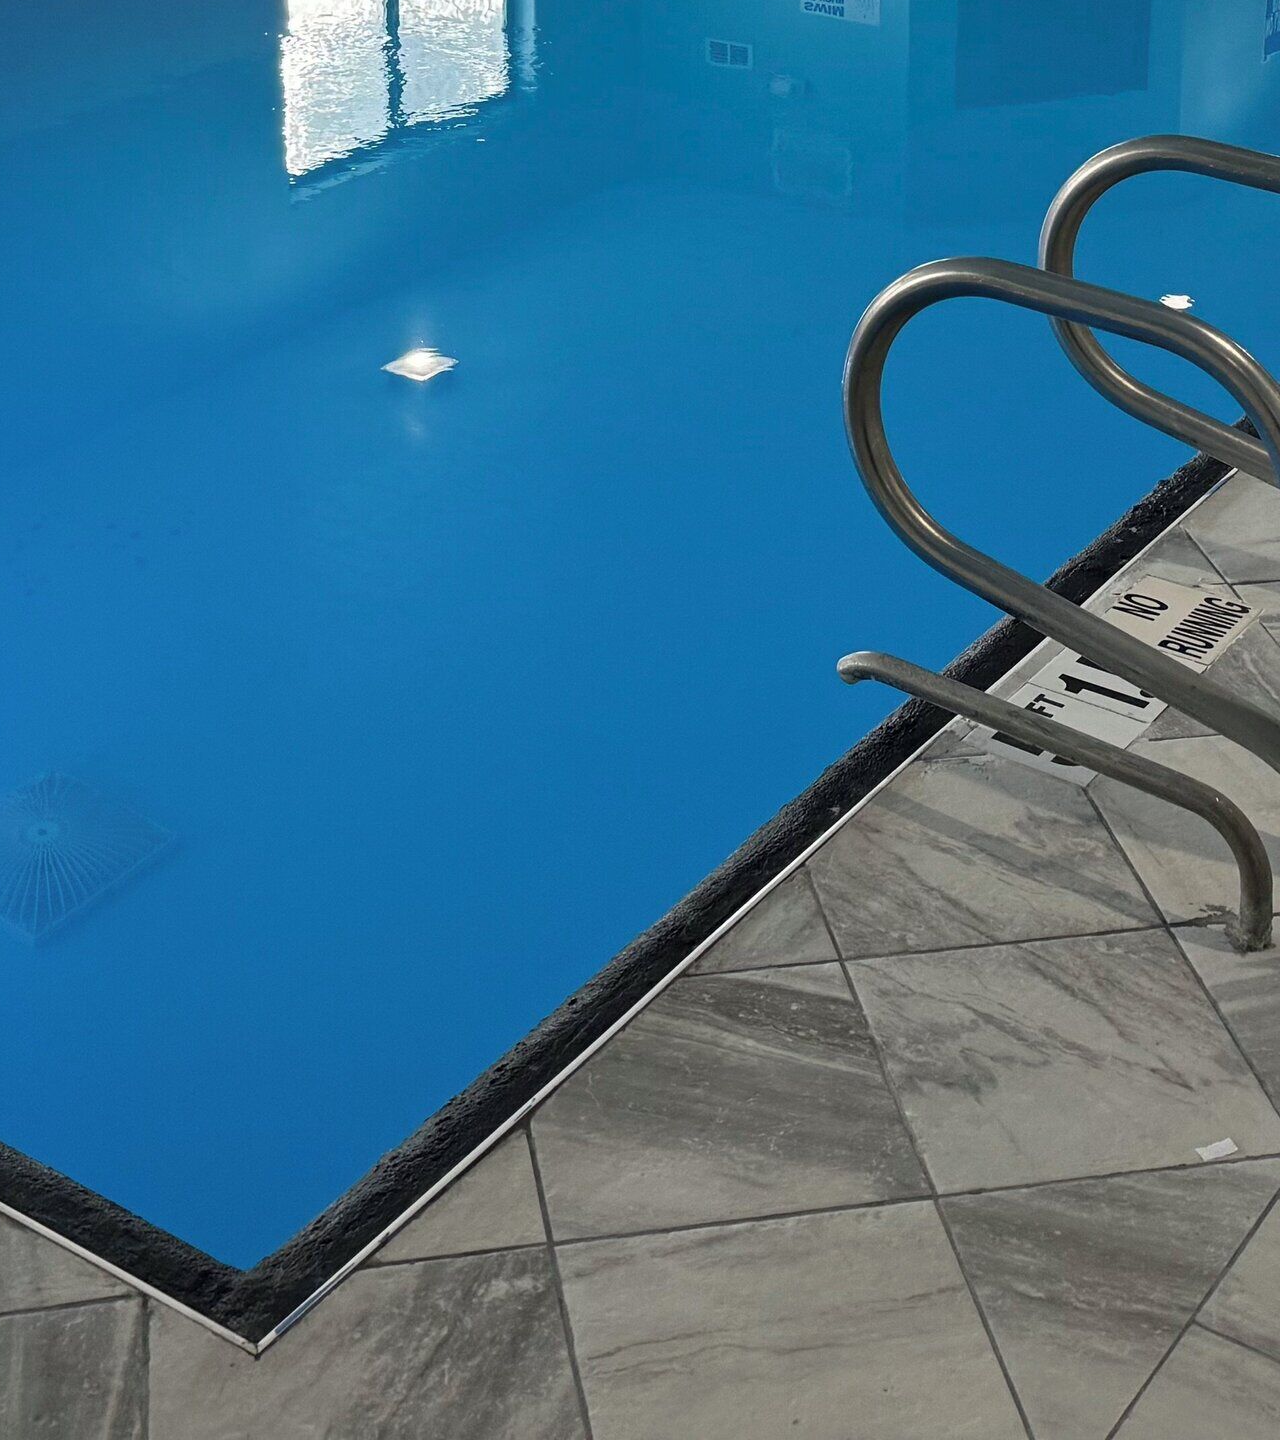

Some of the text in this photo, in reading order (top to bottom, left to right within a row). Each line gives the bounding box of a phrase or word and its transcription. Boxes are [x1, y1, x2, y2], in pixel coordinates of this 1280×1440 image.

[1112, 594, 1169, 621] NO
[1158, 597, 1252, 659] RUNNING
[1024, 693, 1065, 718] FT
